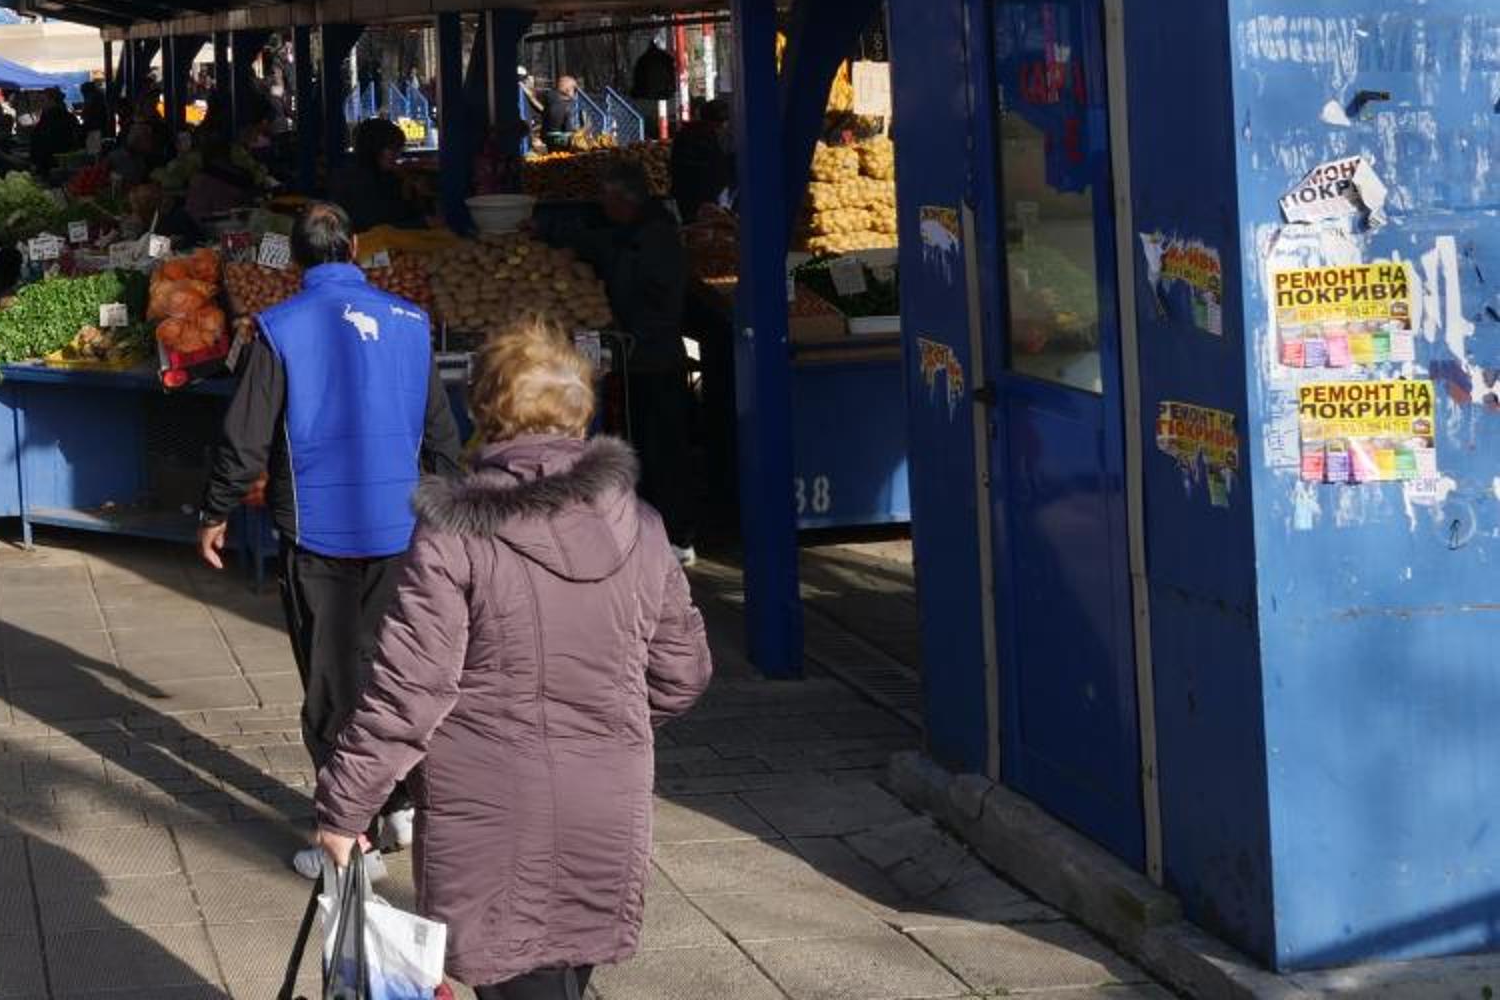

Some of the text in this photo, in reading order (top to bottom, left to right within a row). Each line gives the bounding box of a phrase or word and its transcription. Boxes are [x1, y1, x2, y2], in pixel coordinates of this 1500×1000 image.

[1275, 266, 1408, 289] РЕМОНТ НА
[1276, 282, 1408, 307] ПОКРИВИ
[1300, 383, 1430, 403] РЕМОНТ НА
[1300, 400, 1431, 419] ПОКРИВИ
